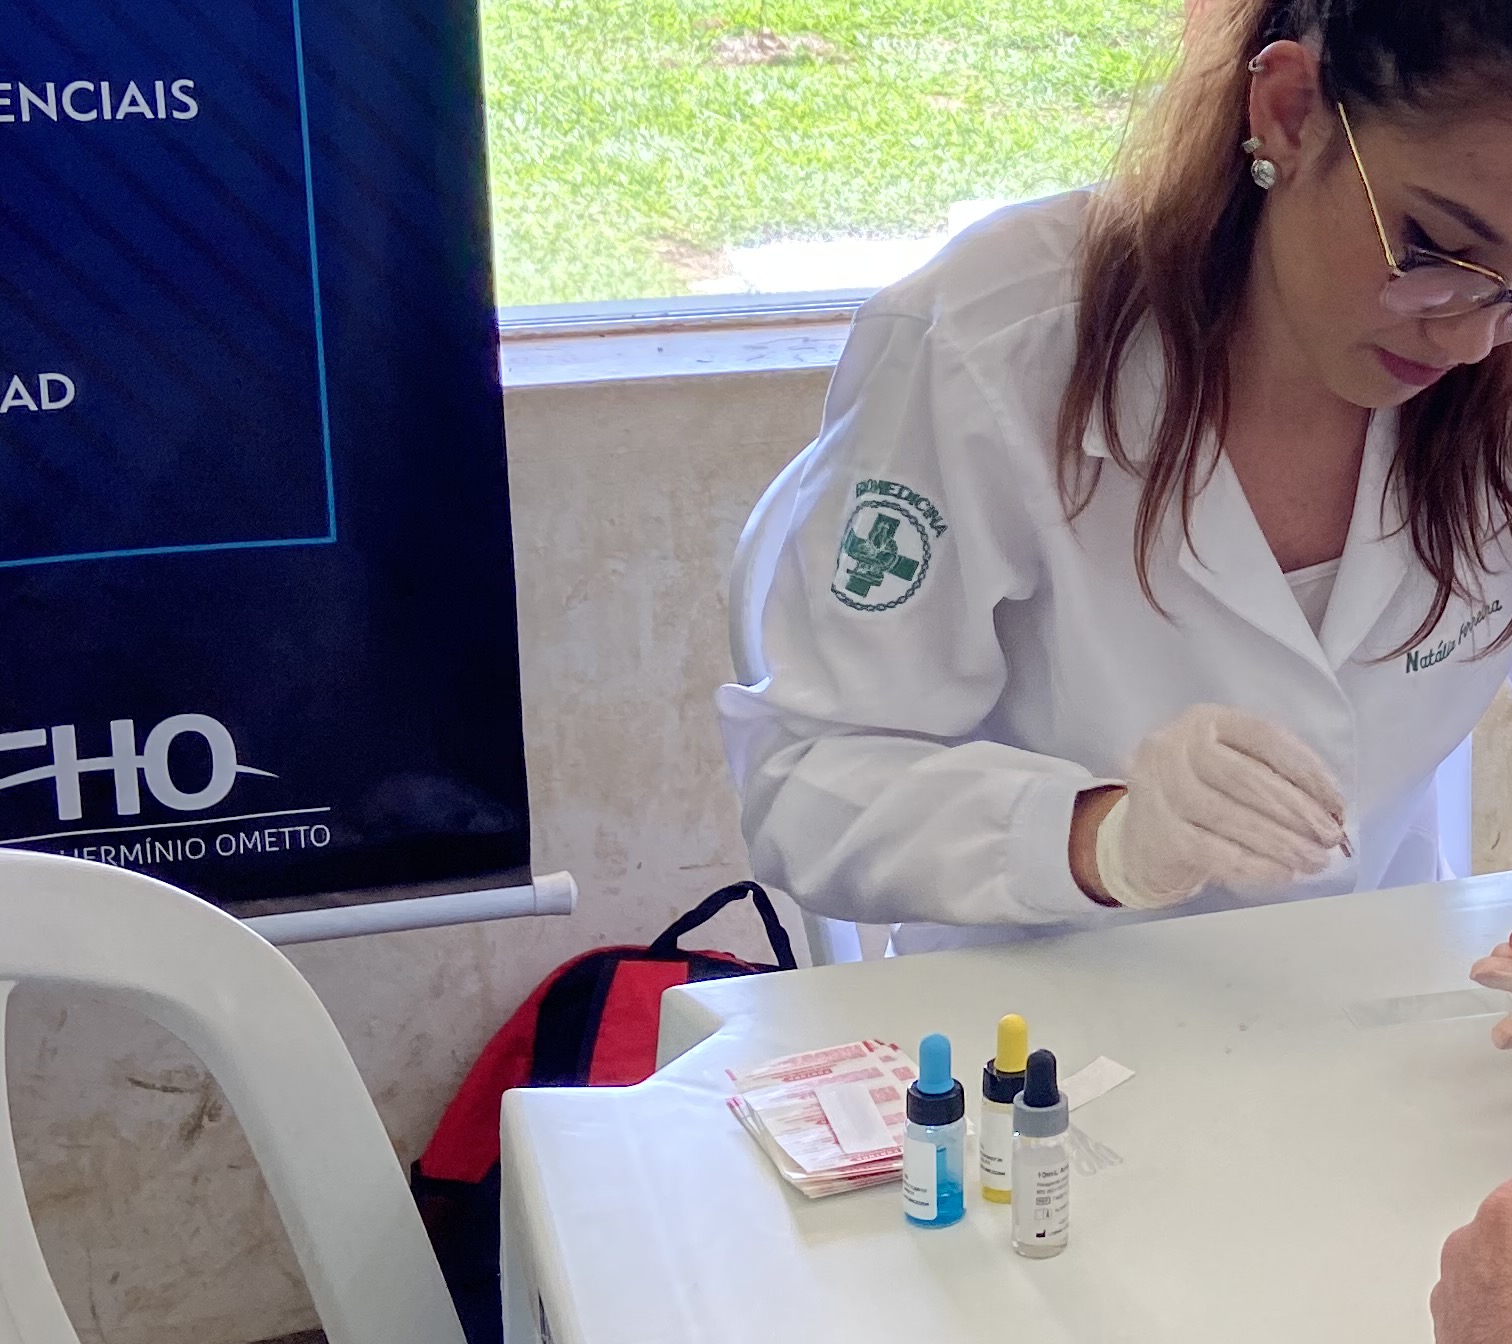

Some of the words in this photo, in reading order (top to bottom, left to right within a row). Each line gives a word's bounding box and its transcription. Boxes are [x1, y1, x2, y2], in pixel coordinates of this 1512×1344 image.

[0, 372, 76, 414] AD
[60, 837, 206, 868] ERMÍNIO
[215, 824, 331, 856] OMETTO
